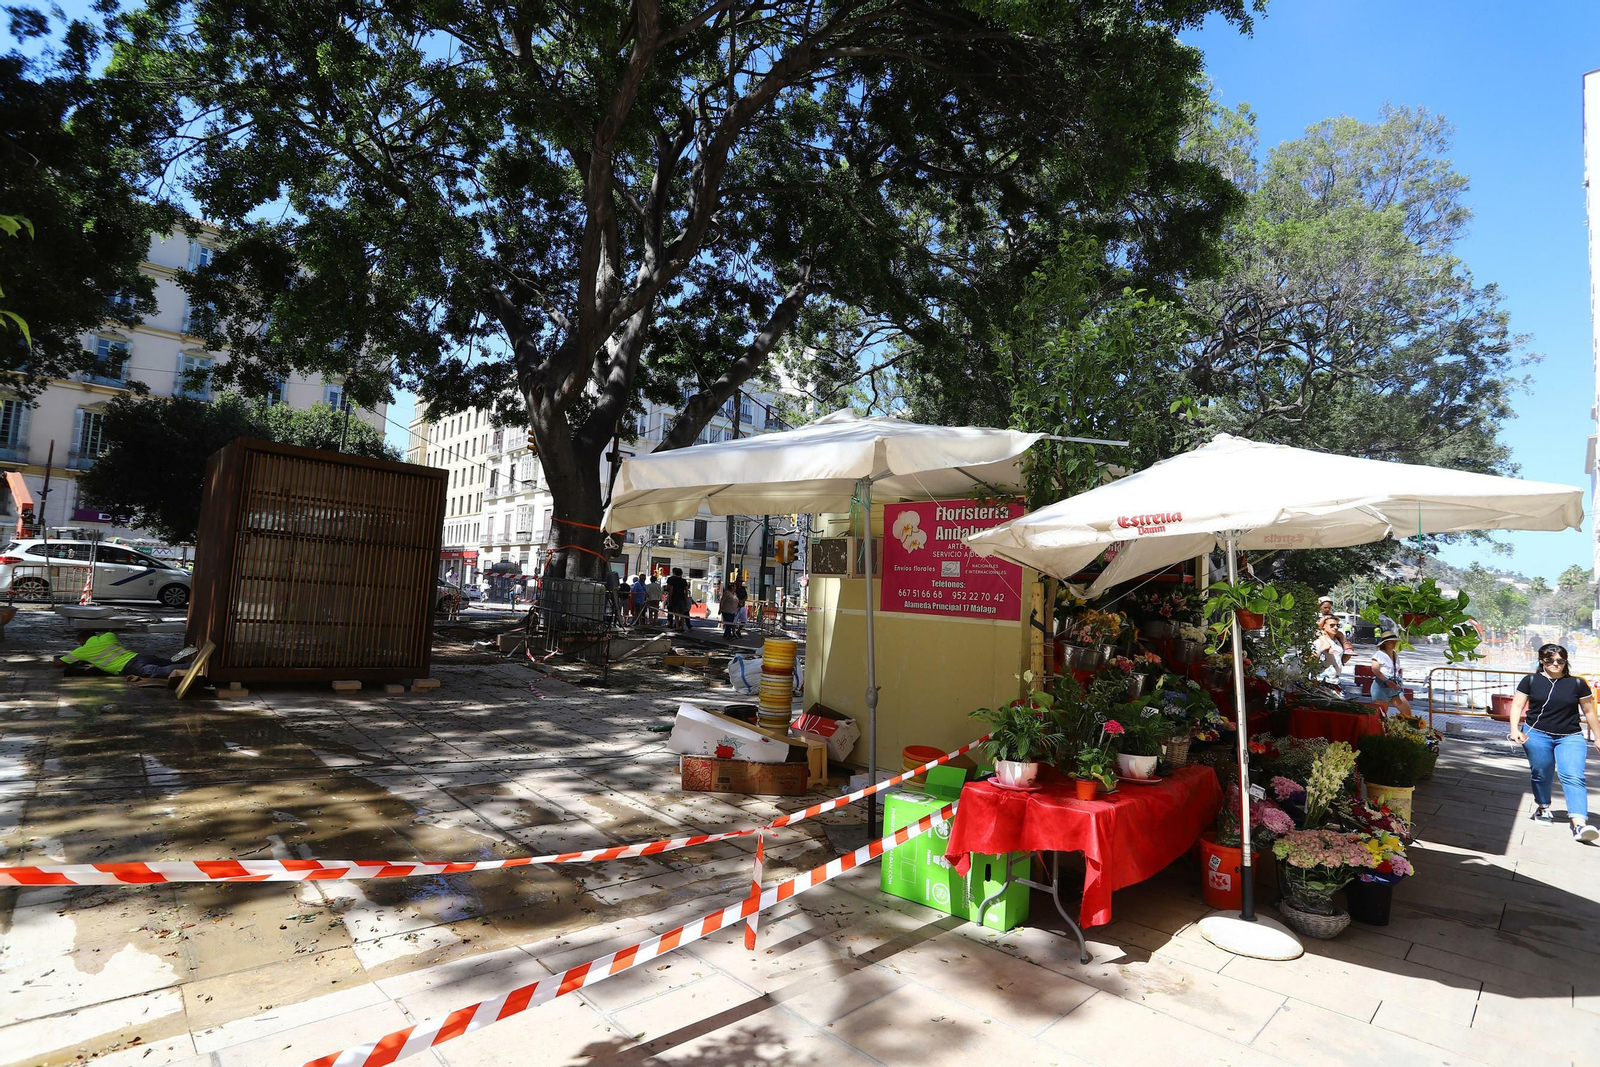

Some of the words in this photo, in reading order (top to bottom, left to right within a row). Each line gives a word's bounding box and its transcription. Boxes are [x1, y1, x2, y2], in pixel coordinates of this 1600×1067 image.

[1117, 511, 1183, 529] Estrella
[1138, 525, 1166, 536] Damm
[932, 550, 962, 558] SERVICIO
[898, 589, 911, 597] 667
[912, 589, 920, 598] 51
[921, 590, 931, 599] 66
[933, 590, 943, 599] 68
[952, 591, 967, 600] 952
[969, 592, 979, 601] 22
[981, 592, 991, 601] 70
[994, 593, 1005, 602] 42
[904, 600, 932, 610] Alameda
[932, 602, 961, 612] Principal
